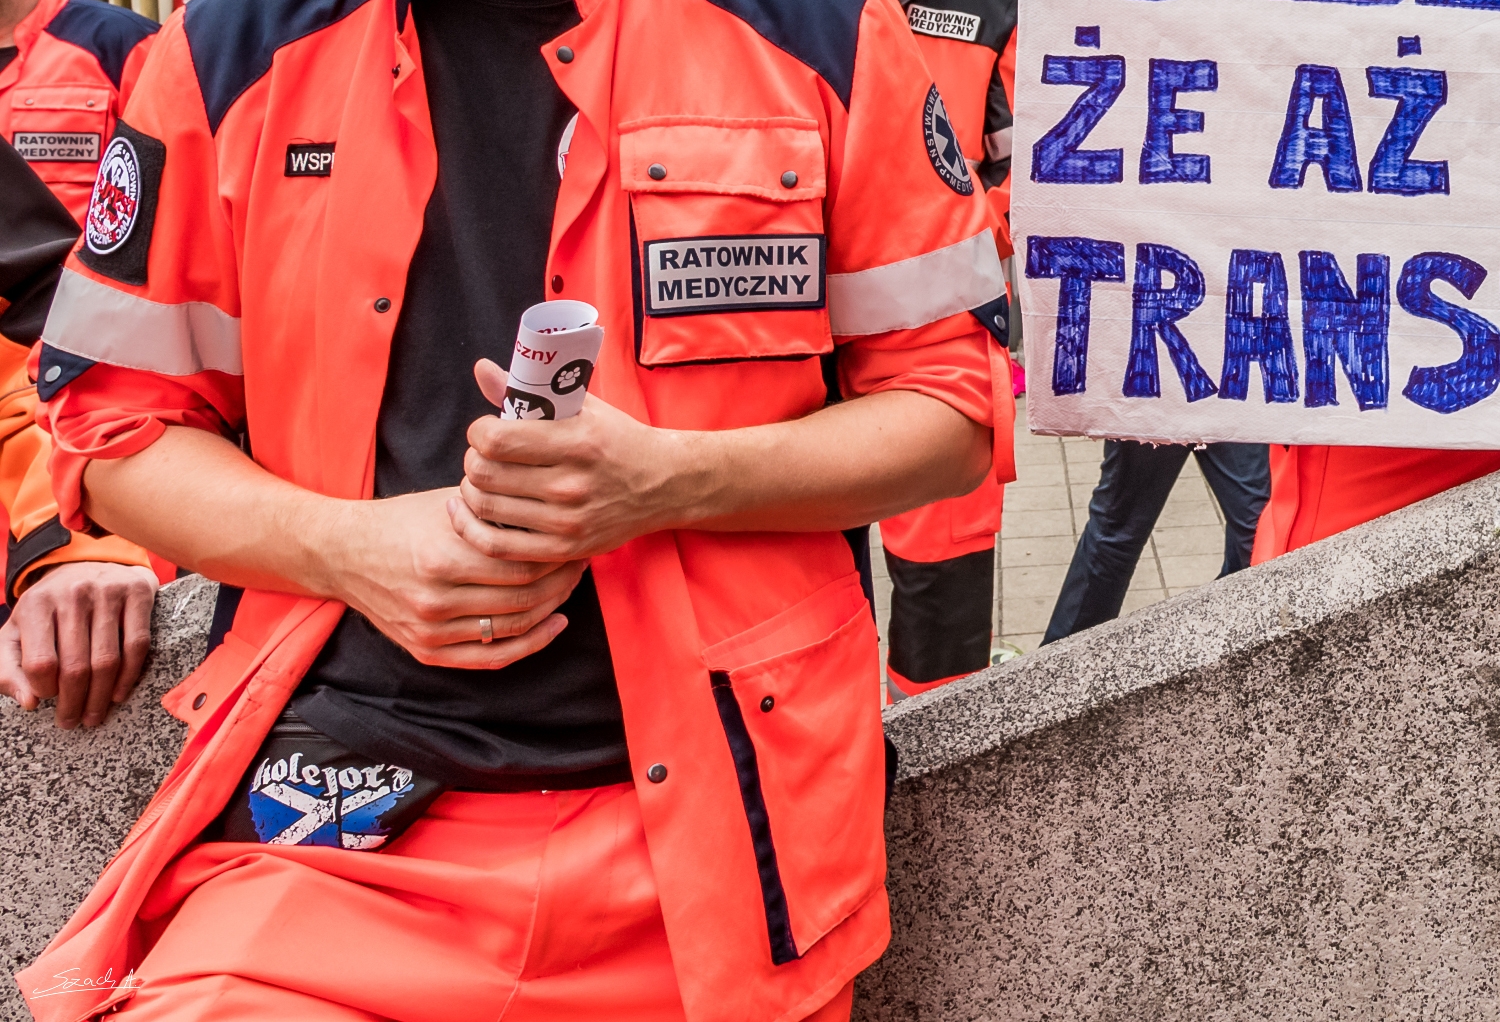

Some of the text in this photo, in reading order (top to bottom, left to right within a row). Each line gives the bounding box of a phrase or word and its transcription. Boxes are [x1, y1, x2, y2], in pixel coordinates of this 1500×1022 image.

[908, 16, 974, 37] MEDYCZNY
[909, 7, 977, 28] RATOWNIK
[1030, 25, 1218, 184] ŻE
[1268, 35, 1451, 195] AŻ
[19, 136, 94, 145] RATOWNIK
[18, 148, 95, 157] MEDYCZNY
[659, 245, 809, 270] RATOWNIK
[658, 274, 812, 302] MEDYCZNY
